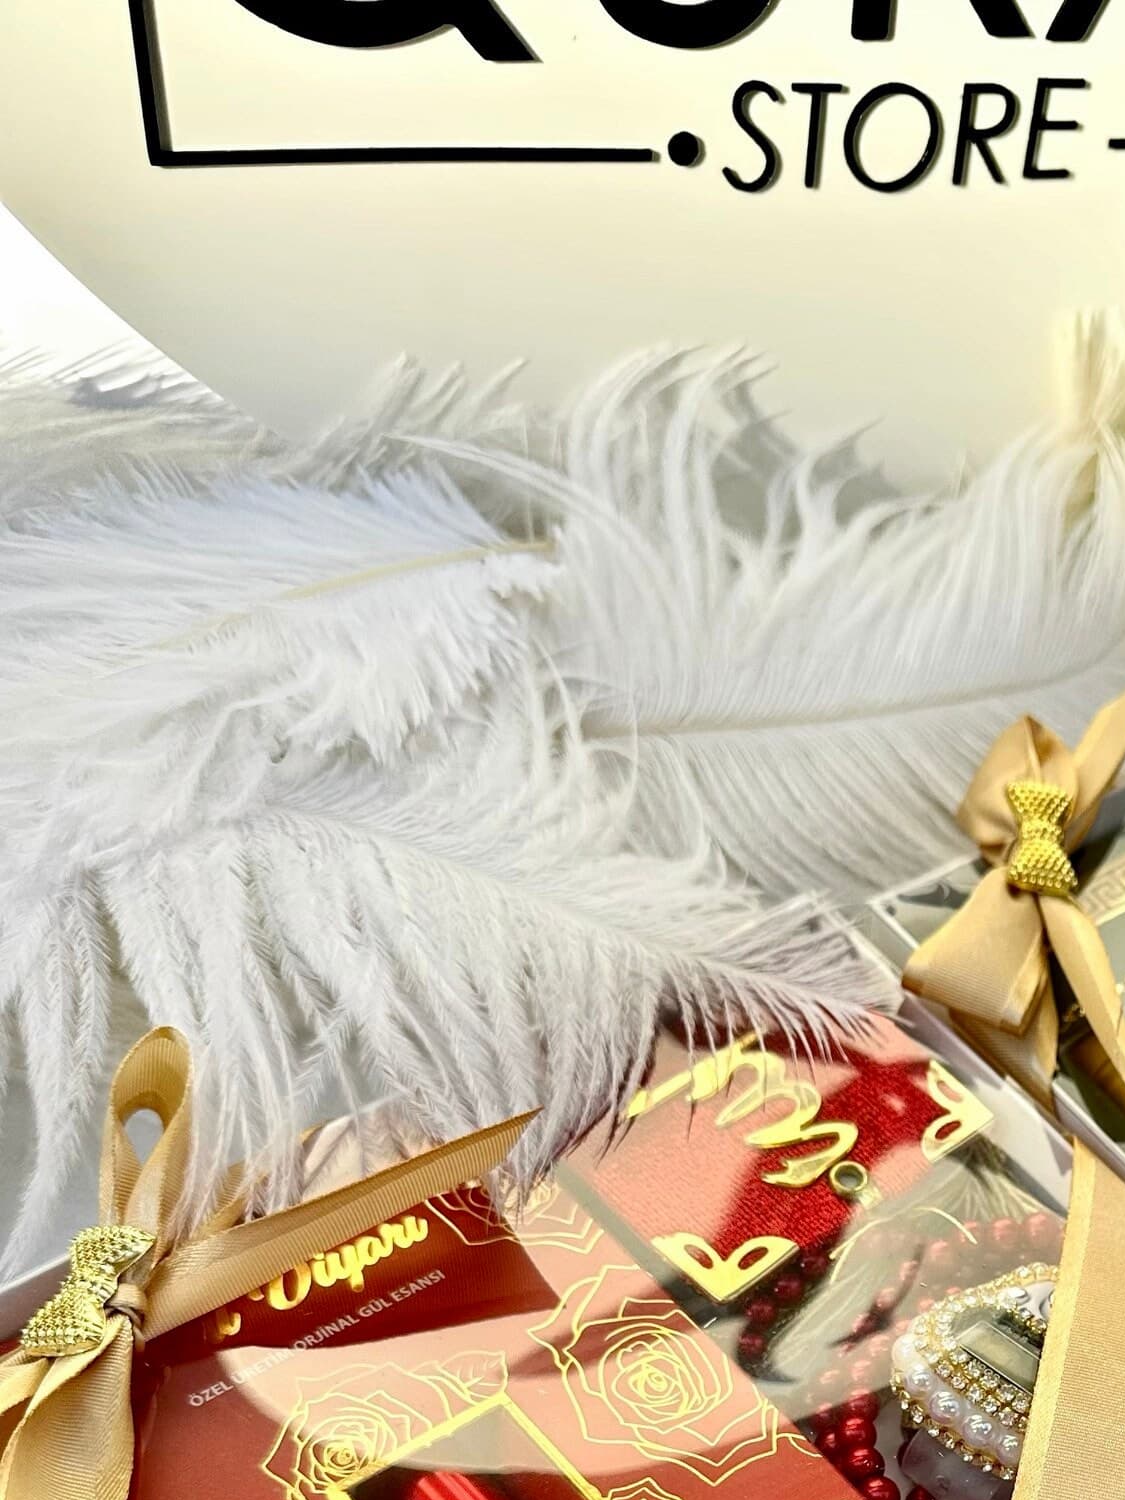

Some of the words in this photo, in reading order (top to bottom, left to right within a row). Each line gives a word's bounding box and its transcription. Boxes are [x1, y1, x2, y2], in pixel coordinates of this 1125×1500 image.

[189, 1379, 235, 1408] ÖZEL
[359, 1297, 393, 1319] GÜL
[390, 1268, 446, 1302] ESANSI
